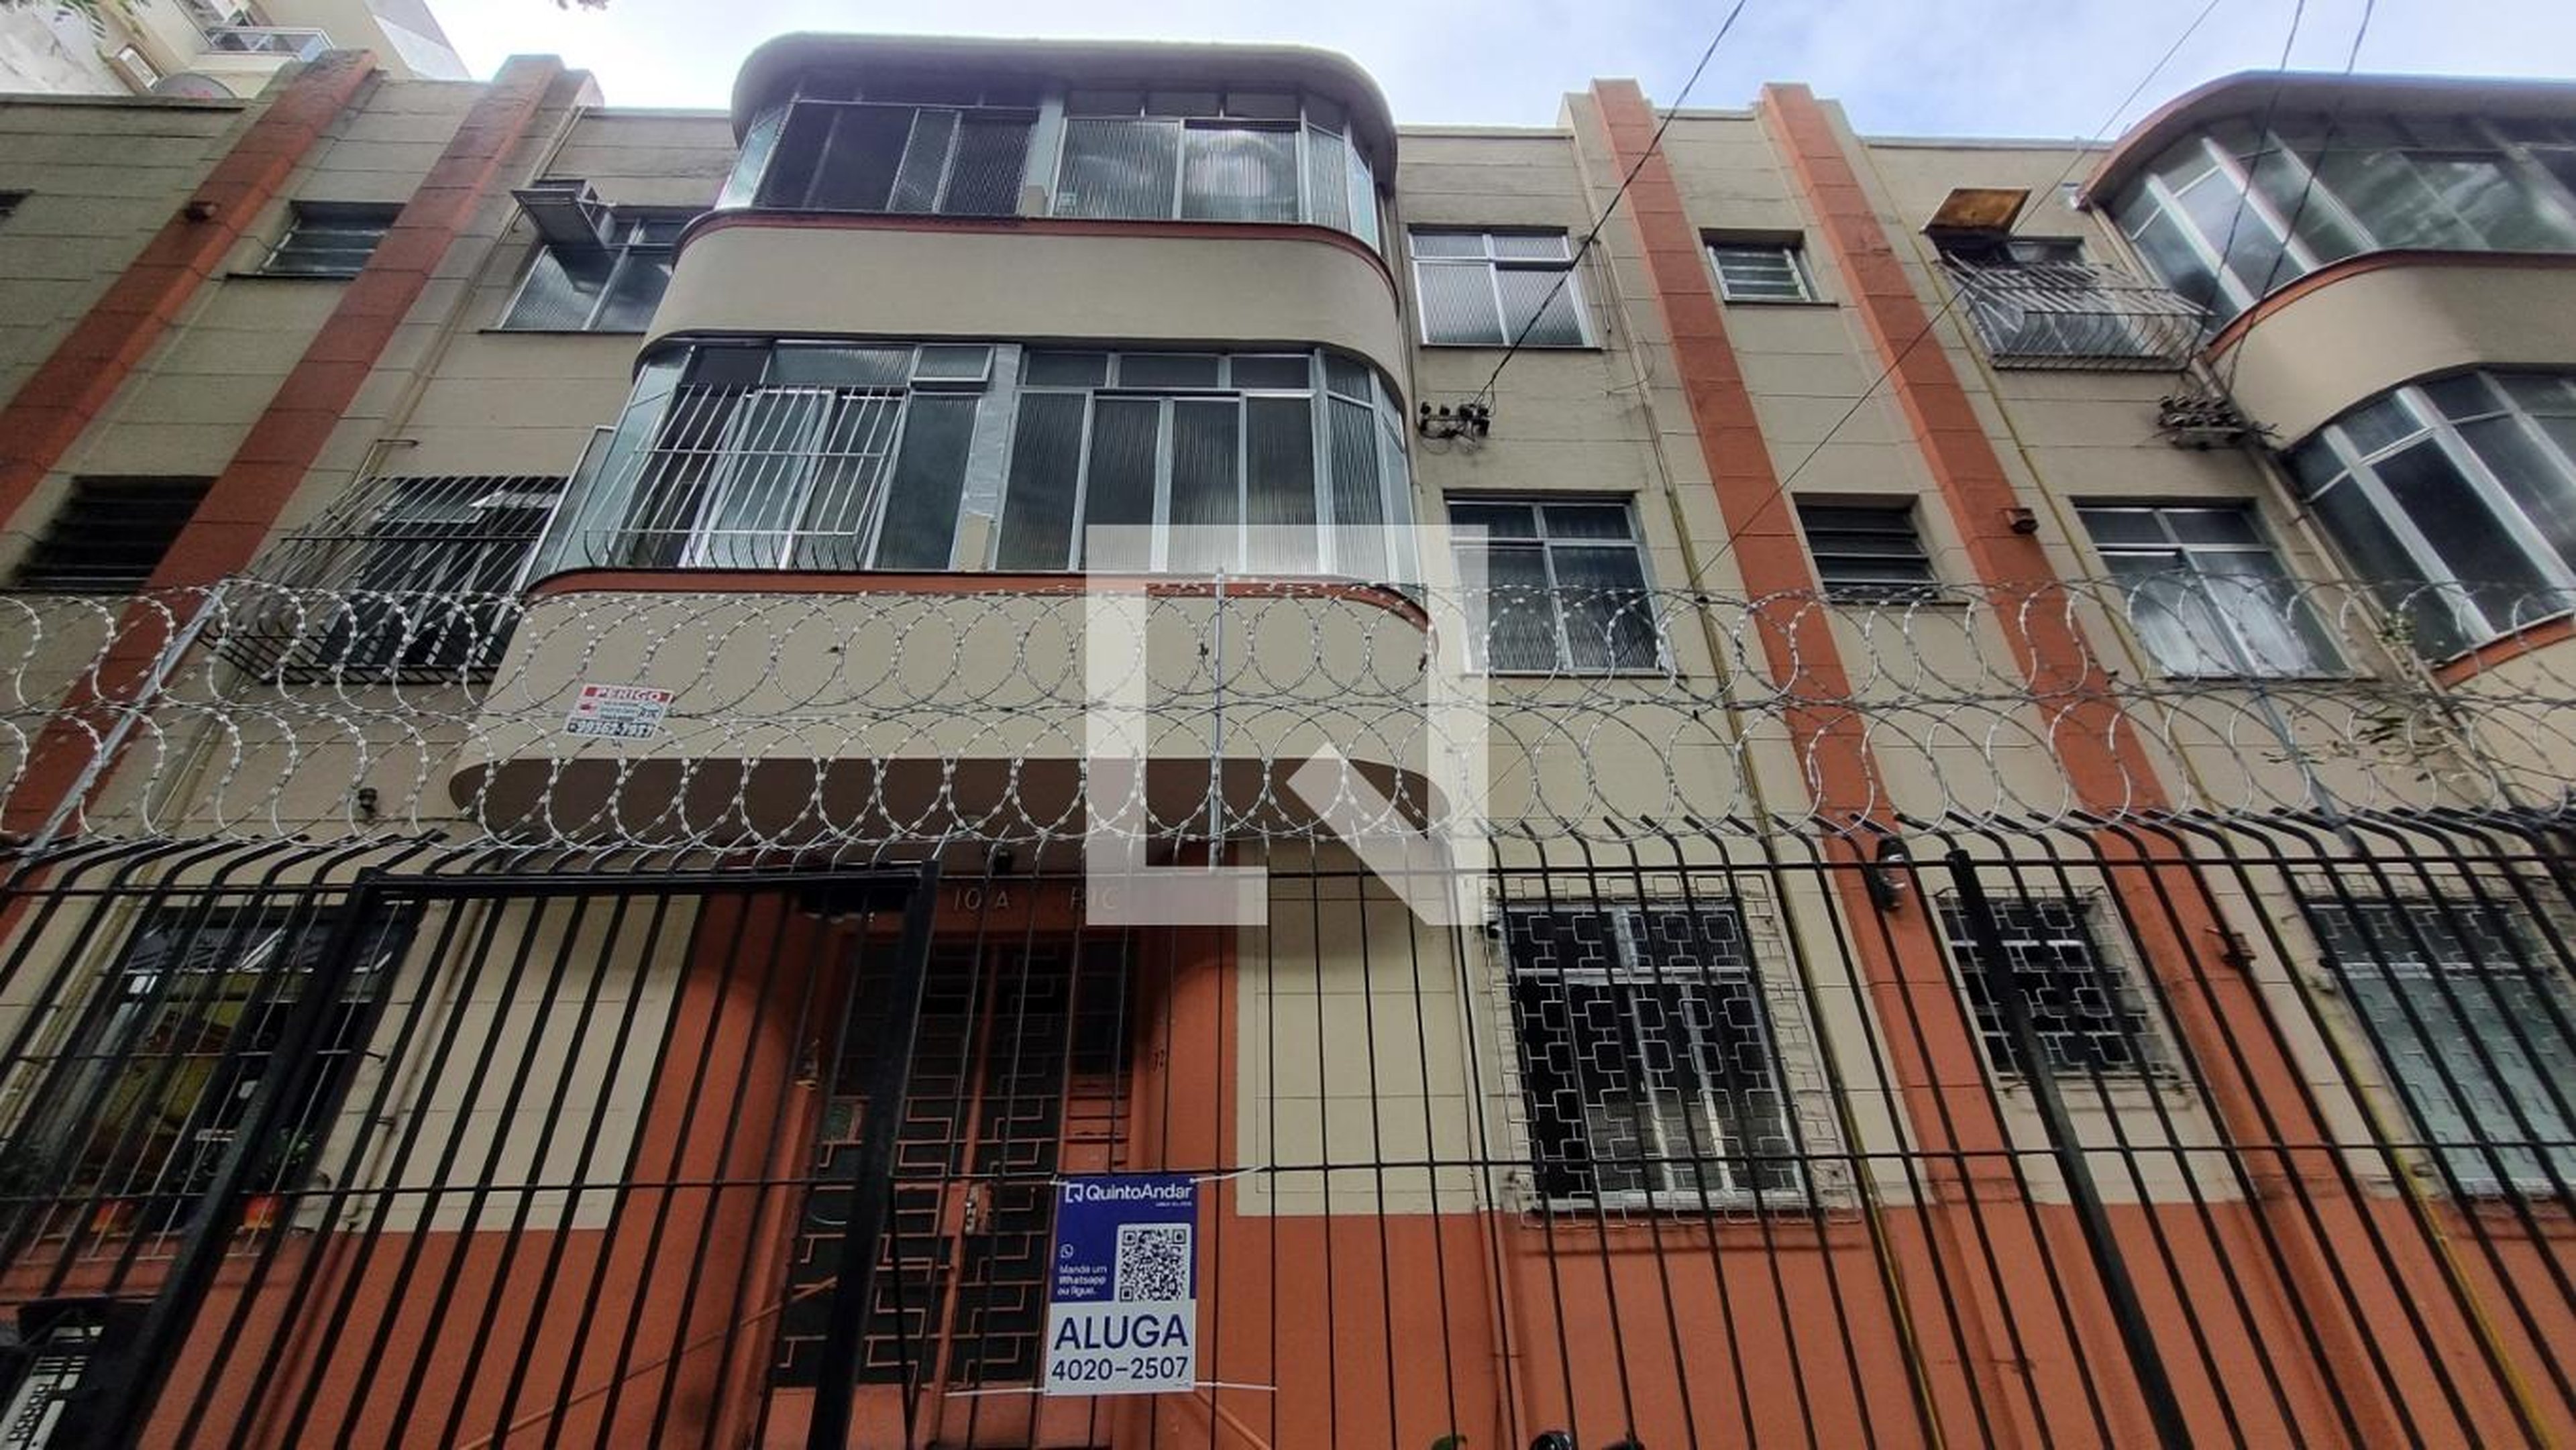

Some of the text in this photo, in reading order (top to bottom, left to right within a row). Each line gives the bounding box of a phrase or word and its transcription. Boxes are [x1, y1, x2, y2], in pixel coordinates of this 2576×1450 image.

[594, 687, 661, 701] PERIGO
[1086, 1182, 1193, 1201] QuintoAndar
[1054, 1313, 1189, 1351] ALUGA
[1051, 1356, 1189, 1382] 4020-2507
